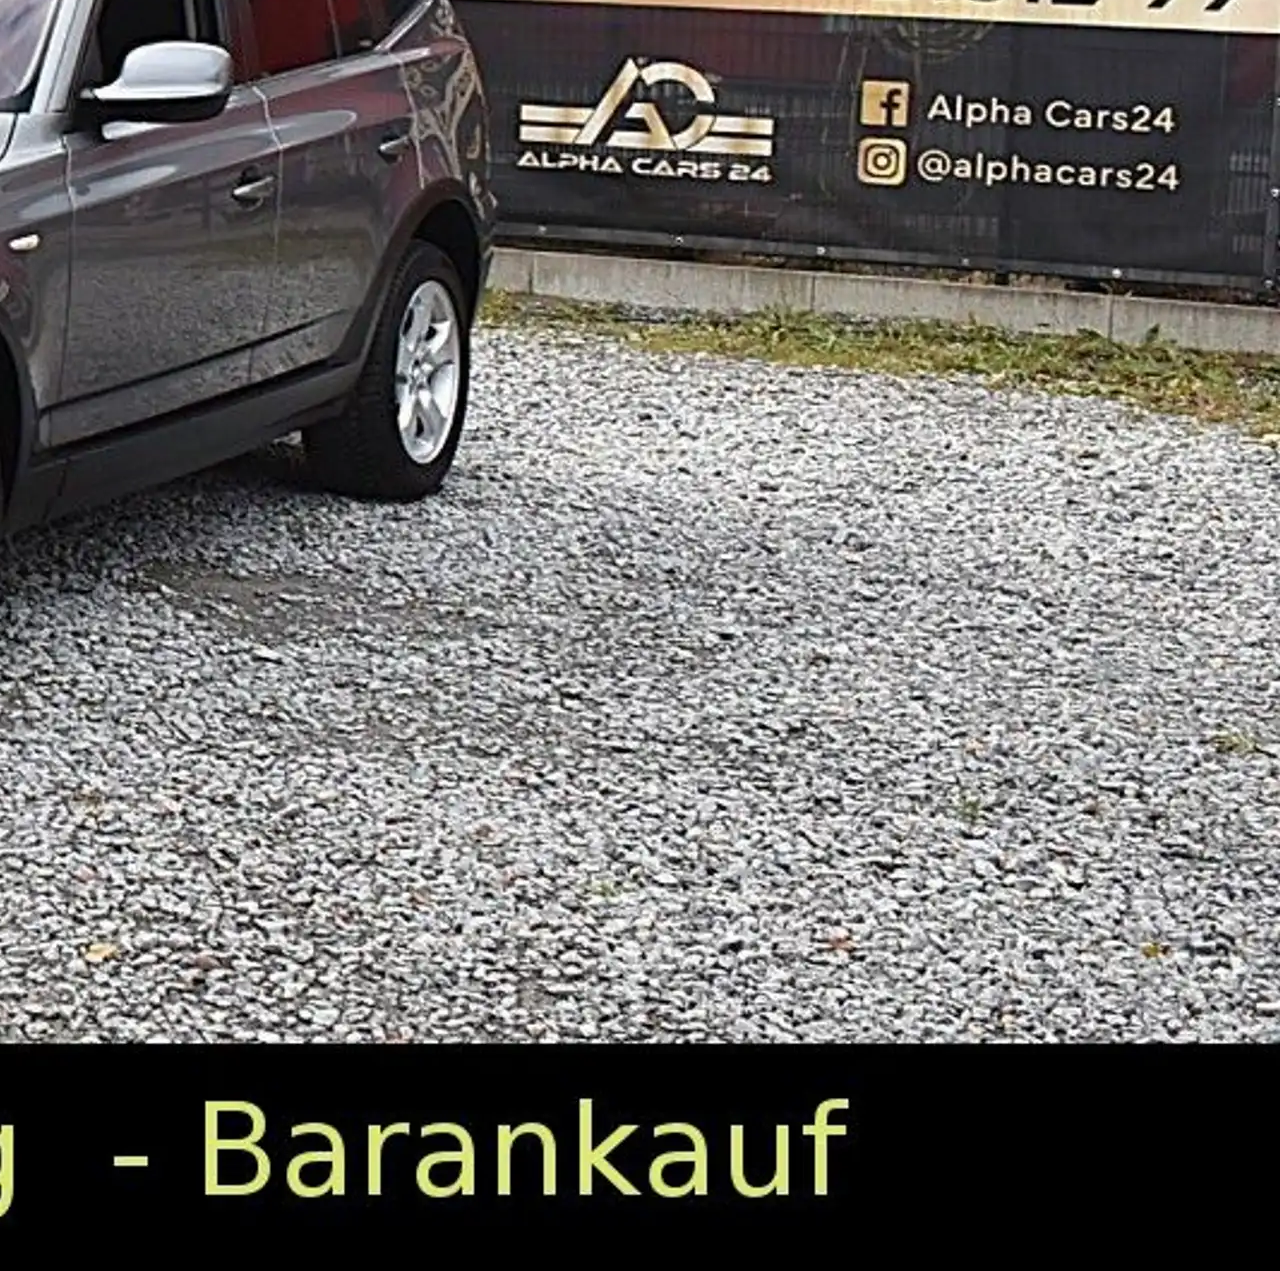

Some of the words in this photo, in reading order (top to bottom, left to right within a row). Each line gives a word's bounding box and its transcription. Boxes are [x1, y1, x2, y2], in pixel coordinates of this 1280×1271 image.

[927, 92, 1031, 130] Alpha
[1044, 99, 1175, 134] Cars24
[517, 150, 623, 173] ALPHA
[632, 157, 722, 180] CARS
[728, 163, 773, 183] 24
[916, 150, 1180, 191] @alphacars24
